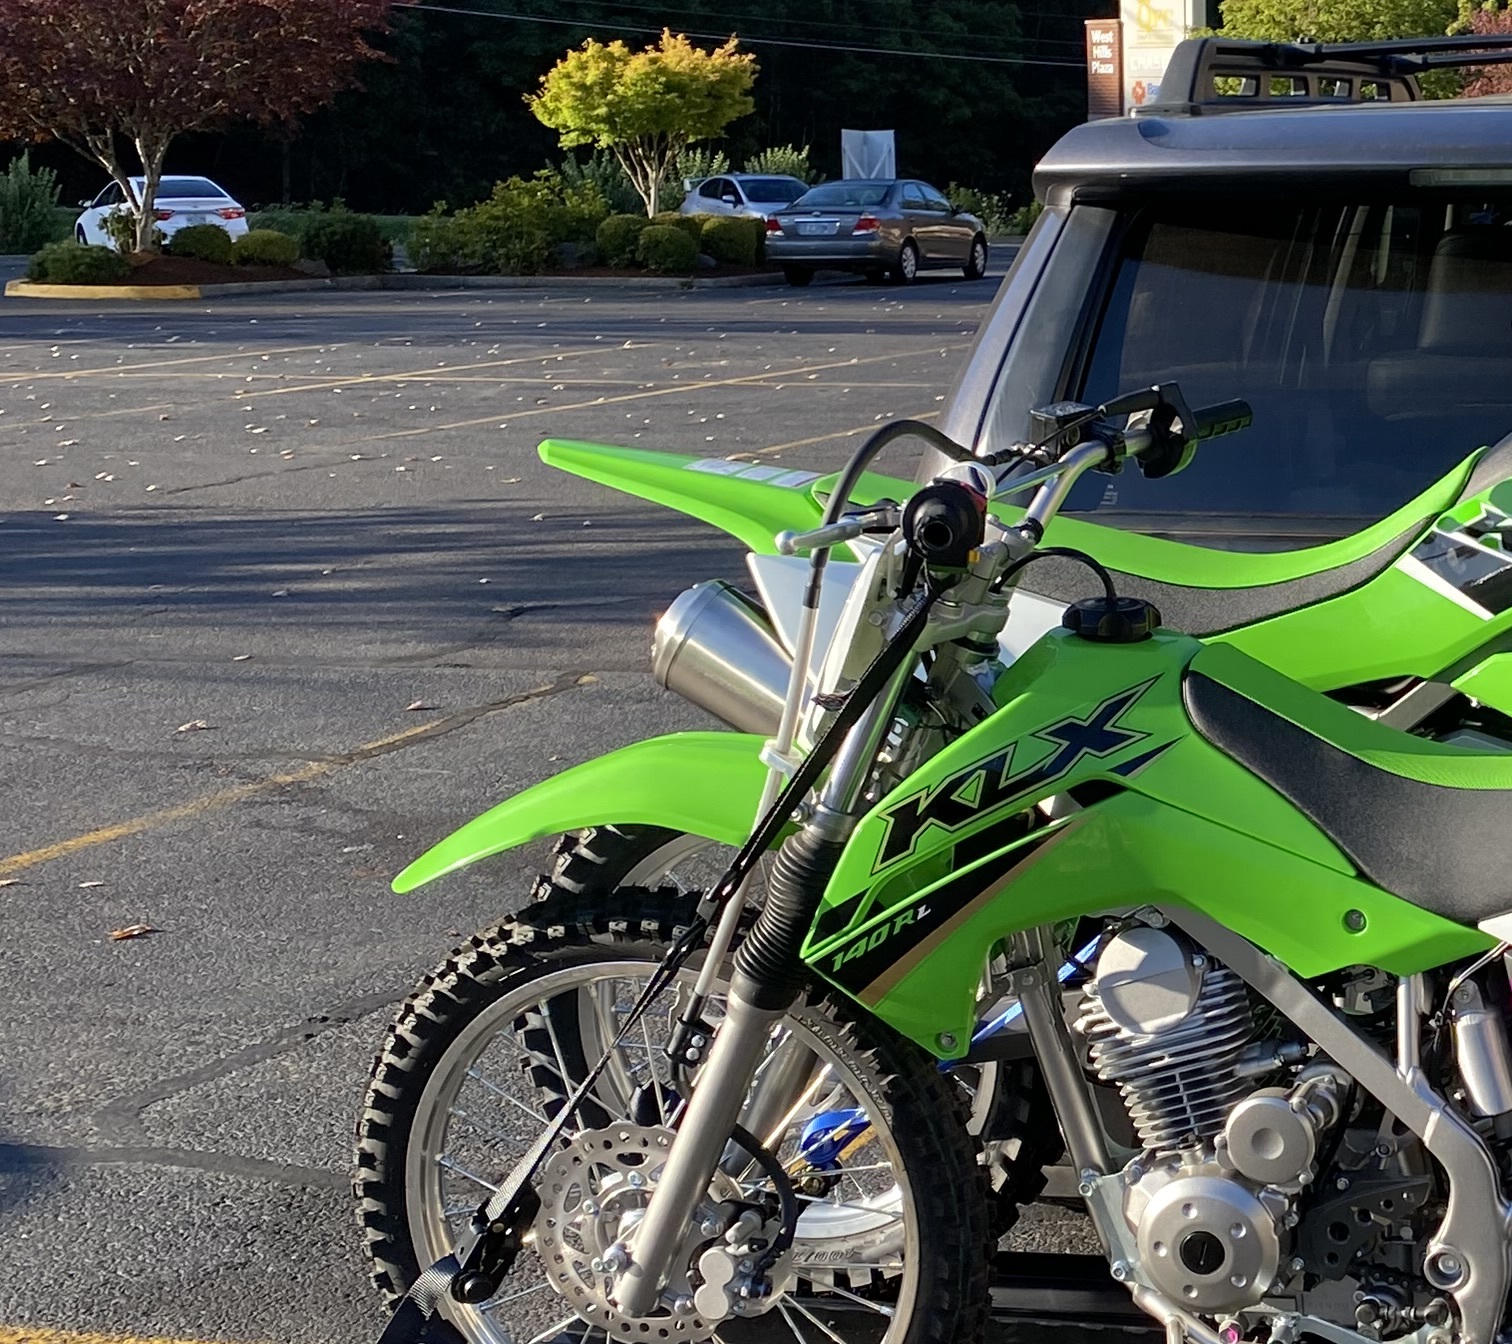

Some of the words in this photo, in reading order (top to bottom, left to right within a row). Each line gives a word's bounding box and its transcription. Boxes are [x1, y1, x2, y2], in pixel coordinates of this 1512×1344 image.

[1091, 29, 1114, 44] West
[1092, 45, 1112, 59] Hills
[1091, 61, 1114, 74] Plaza
[869, 671, 1166, 879] KLX
